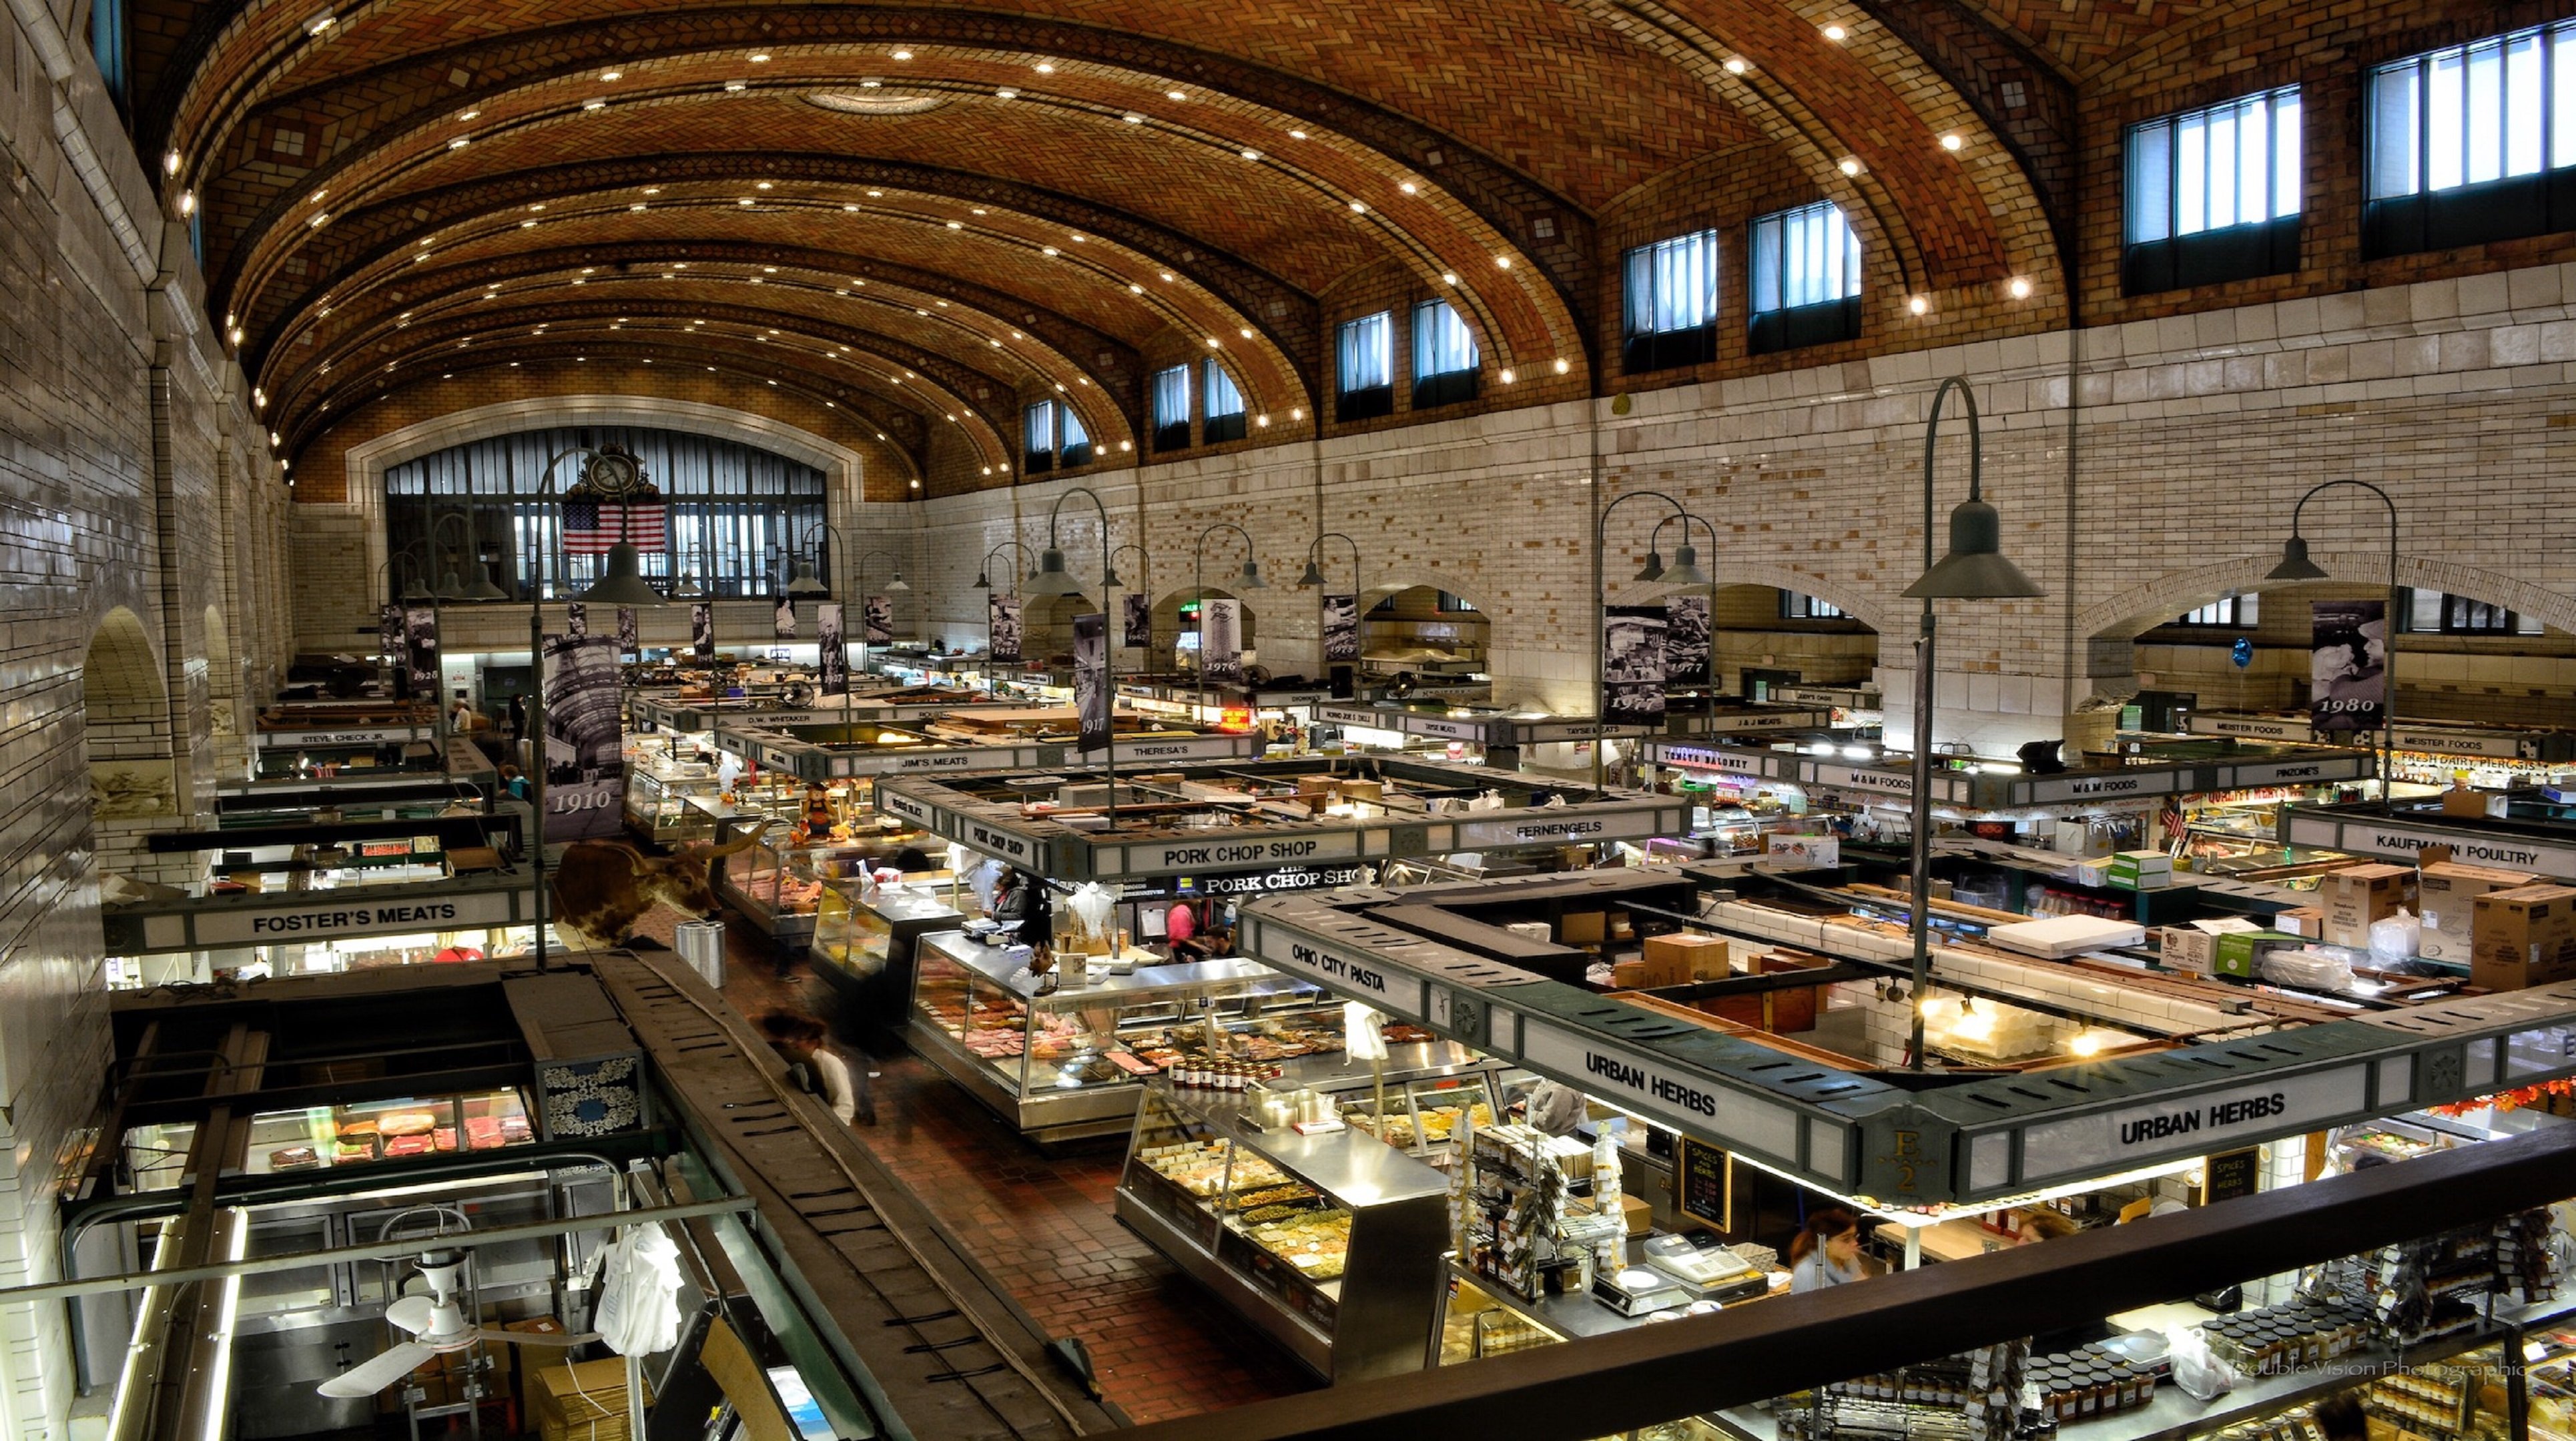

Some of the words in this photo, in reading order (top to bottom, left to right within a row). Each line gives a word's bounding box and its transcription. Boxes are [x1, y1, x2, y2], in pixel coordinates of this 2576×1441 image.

[771, 650, 790, 658] ATM
[1207, 660, 1237, 672] 1976
[1671, 663, 1703, 673] 1977
[1610, 698, 1655, 711] 1977
[2319, 698, 2375, 714] 1980
[747, 716, 766, 724] D.W.
[769, 714, 811, 723] WHITAKER
[1082, 718, 1102, 734] 1917
[1757, 718, 1782, 726] MEATS
[1566, 727, 1591, 735] TAYSE
[2217, 723, 2252, 733] MEISTER
[2254, 725, 2284, 735] FOODS
[302, 735, 332, 743] STEVE
[335, 734, 368, 743] CHECK
[371, 733, 386, 741] JR.
[2404, 737, 2444, 747] MEISTER
[2448, 740, 2483, 750] FOODS
[1134, 746, 1189, 757] THERESA'S
[902, 758, 930, 768] JIM'S
[933, 756, 968, 766] MEATS
[2402, 753, 2437, 764] FRESH
[2439, 755, 2477, 768] DAIRY,
[2276, 767, 2319, 778] PINZONE'S
[1851, 773, 1859, 783] M
[1860, 775, 1867, 784] &
[1869, 775, 1877, 785] M
[1879, 776, 1911, 789] FOODS
[2073, 783, 2081, 794] M
[2083, 783, 2091, 793] &
[2092, 783, 2102, 793] M
[2104, 780, 2138, 791] FOODS
[553, 790, 611, 815] 1910
[1516, 820, 1602, 839] FERNENGELS
[1977, 824, 2003, 834] BBQ
[973, 827, 988, 844] PORK
[990, 833, 1006, 851] CHOP
[1008, 839, 1024, 857] SHOP
[1165, 848, 1211, 866] PORK
[1217, 845, 1264, 863] CHOP
[1270, 841, 1317, 858] SHOP
[2376, 835, 2461, 856] KAUFMN
[2467, 845, 2539, 865] POULTRY
[1205, 876, 1263, 894] PORK
[1265, 872, 1321, 889] CHOP
[253, 909, 371, 933] FOSTER'S
[377, 903, 456, 925] MEATS
[1292, 943, 1317, 967] OHIO
[1321, 955, 1346, 979] CITY
[1350, 965, 1385, 993] PASTA
[1586, 1051, 1644, 1091] URBAN
[1650, 1075, 1716, 1117] HERBS
[2120, 1108, 2201, 1145] URBAN
[2210, 1092, 2286, 1126] HERBS
[1894, 1129, 1921, 1157] E
[1897, 1165, 1916, 1192] 2
